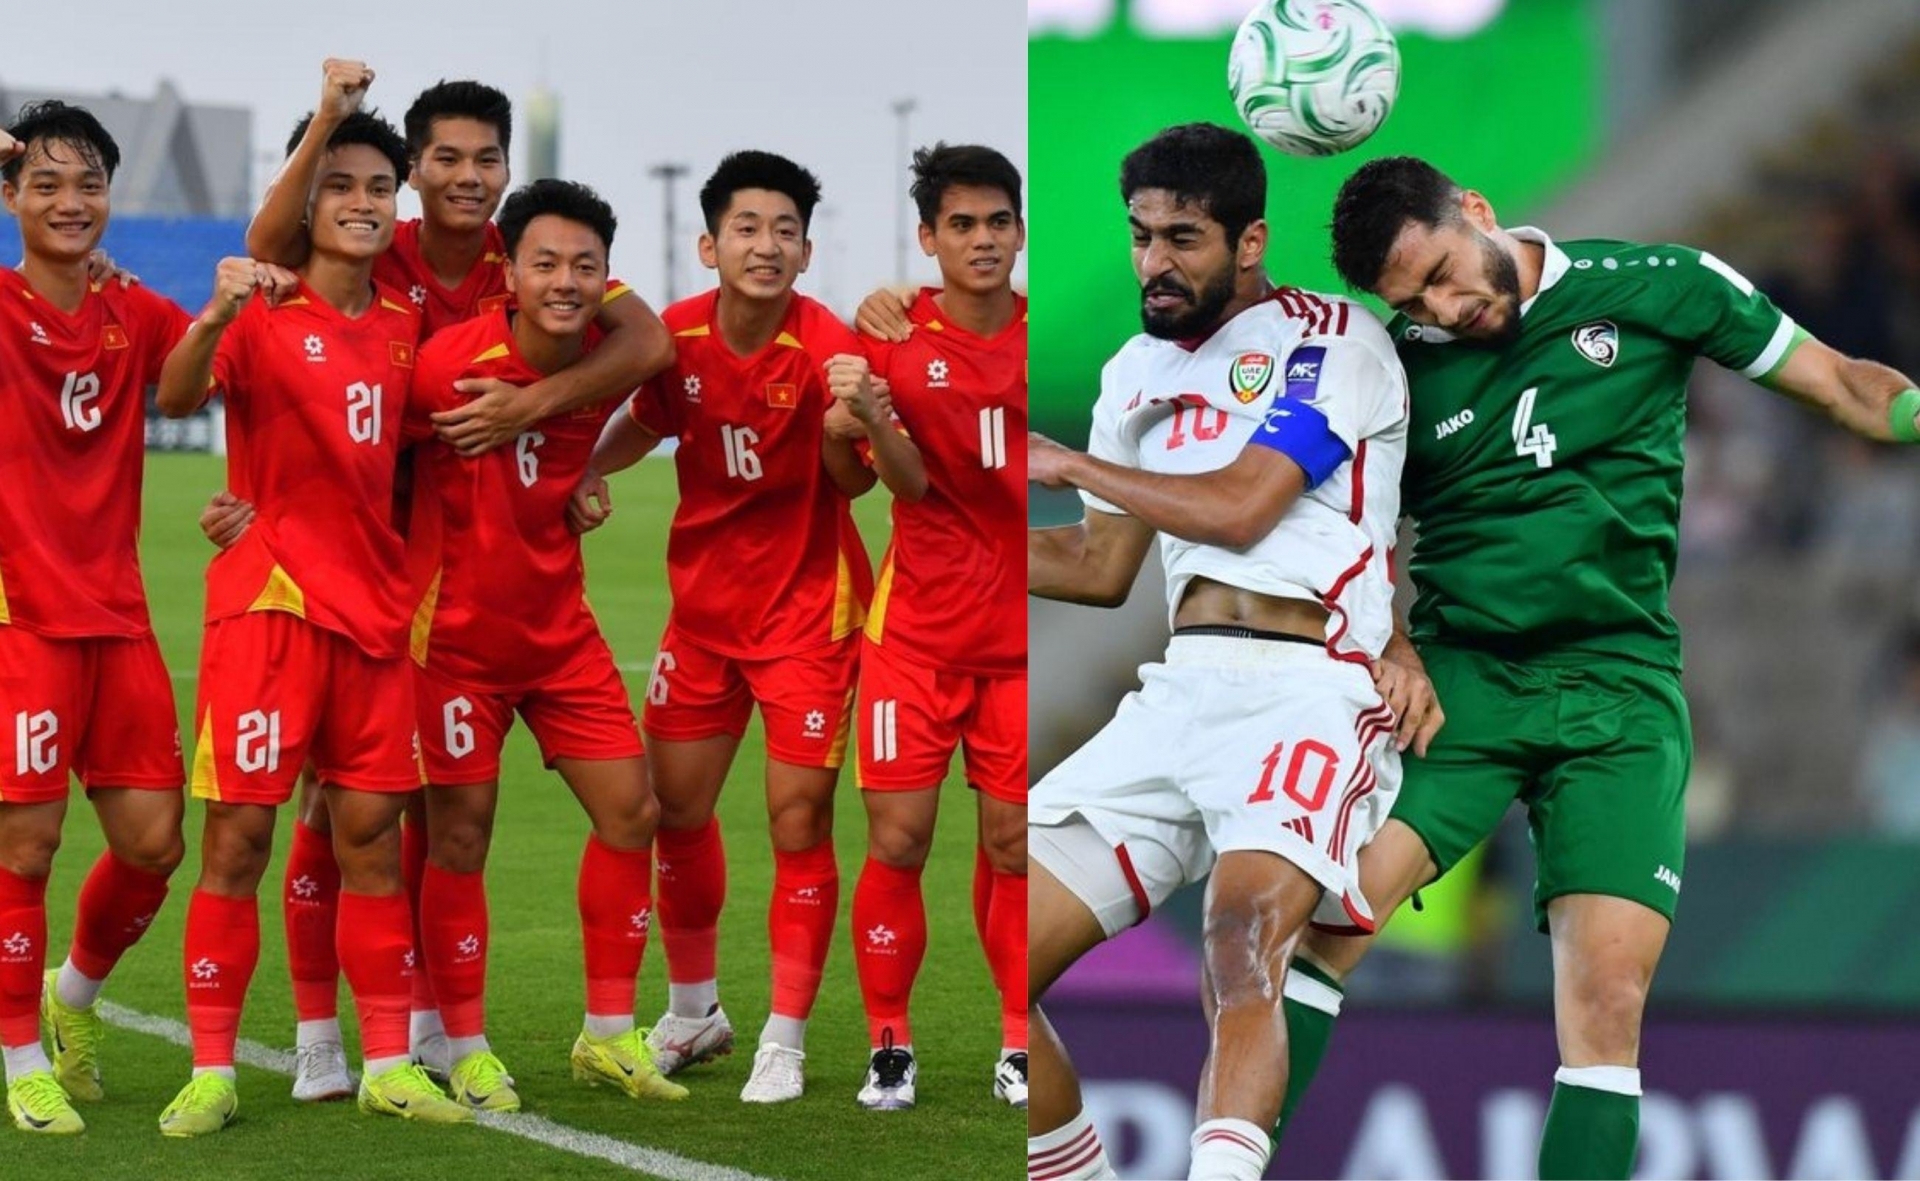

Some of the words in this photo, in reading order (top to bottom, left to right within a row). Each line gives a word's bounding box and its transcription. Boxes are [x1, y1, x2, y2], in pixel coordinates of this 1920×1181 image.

[60, 371, 102, 432] 12
[1288, 362, 1320, 378] AFC
[346, 380, 382, 445] 21
[979, 406, 1006, 469] 11
[1165, 393, 1229, 451] 10
[1435, 408, 1475, 440] JAKO
[1511, 387, 1557, 468] 4
[516, 431, 546, 488] 6
[722, 424, 764, 481] 16
[15, 709, 58, 776] 12
[235, 709, 281, 774] 21
[443, 696, 475, 760] 6
[872, 698, 897, 762] 11
[1247, 738, 1340, 813] 10
